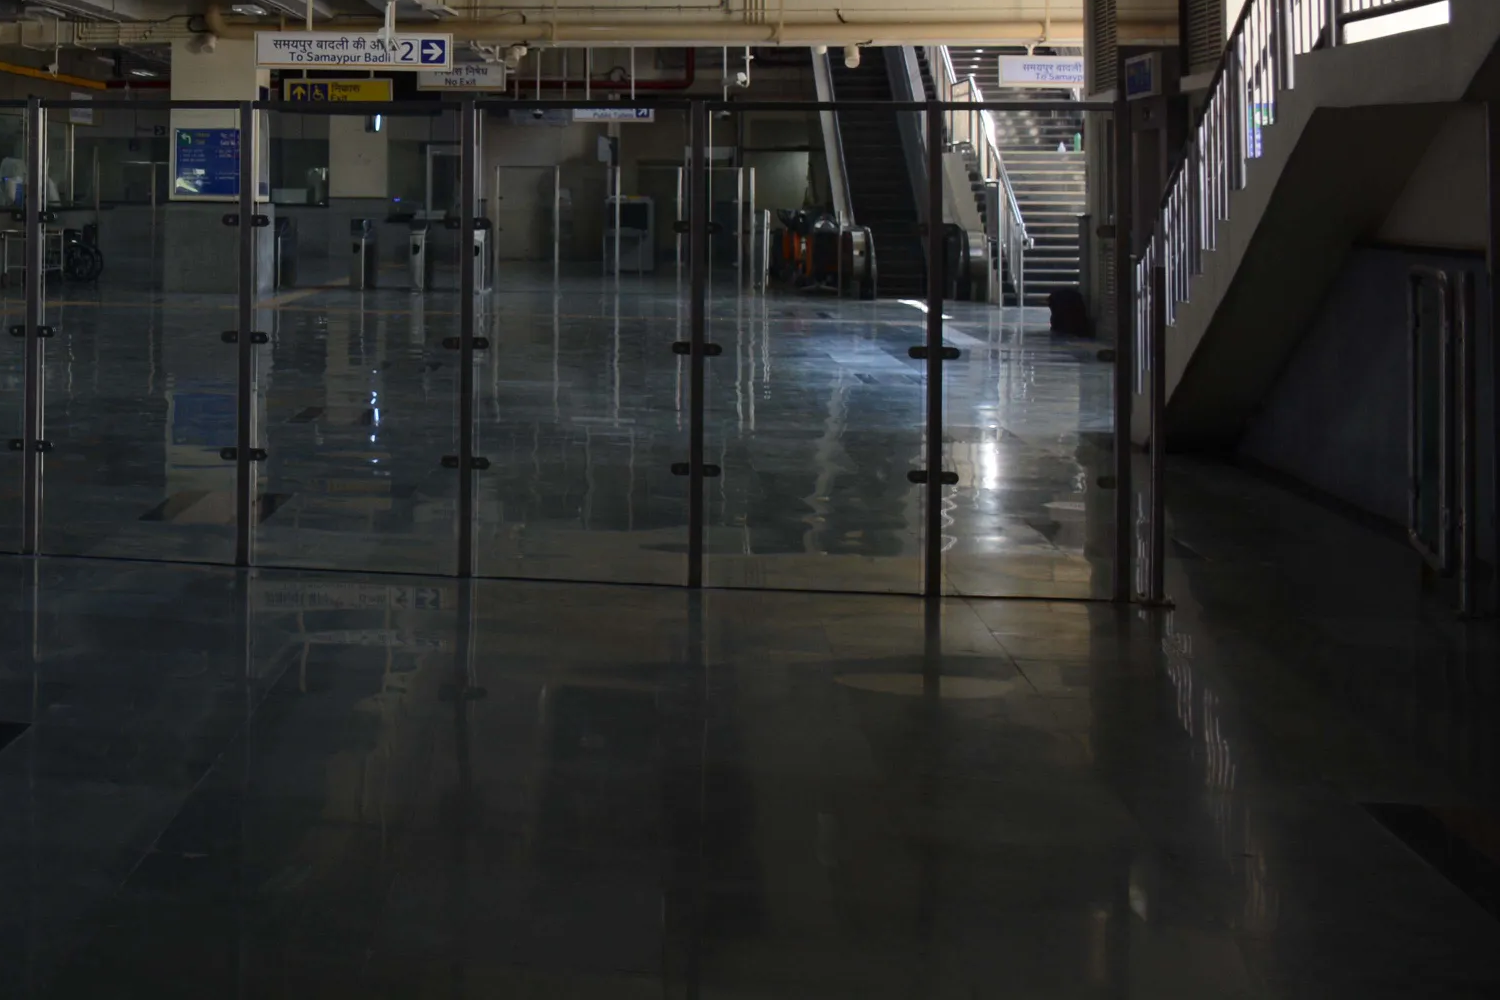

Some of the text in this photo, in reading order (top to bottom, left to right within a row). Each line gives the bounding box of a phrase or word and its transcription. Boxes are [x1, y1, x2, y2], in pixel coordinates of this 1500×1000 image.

[273, 38, 313, 54] समयपुर
[316, 37, 349, 50] बादली
[352, 36, 366, 50] की
[400, 41, 414, 61] 2
[289, 51, 391, 65] To Samaypur Badli
[1023, 62, 1054, 74] समयपुर
[445, 77, 477, 86] No Exit
[1036, 73, 1047, 81] To
